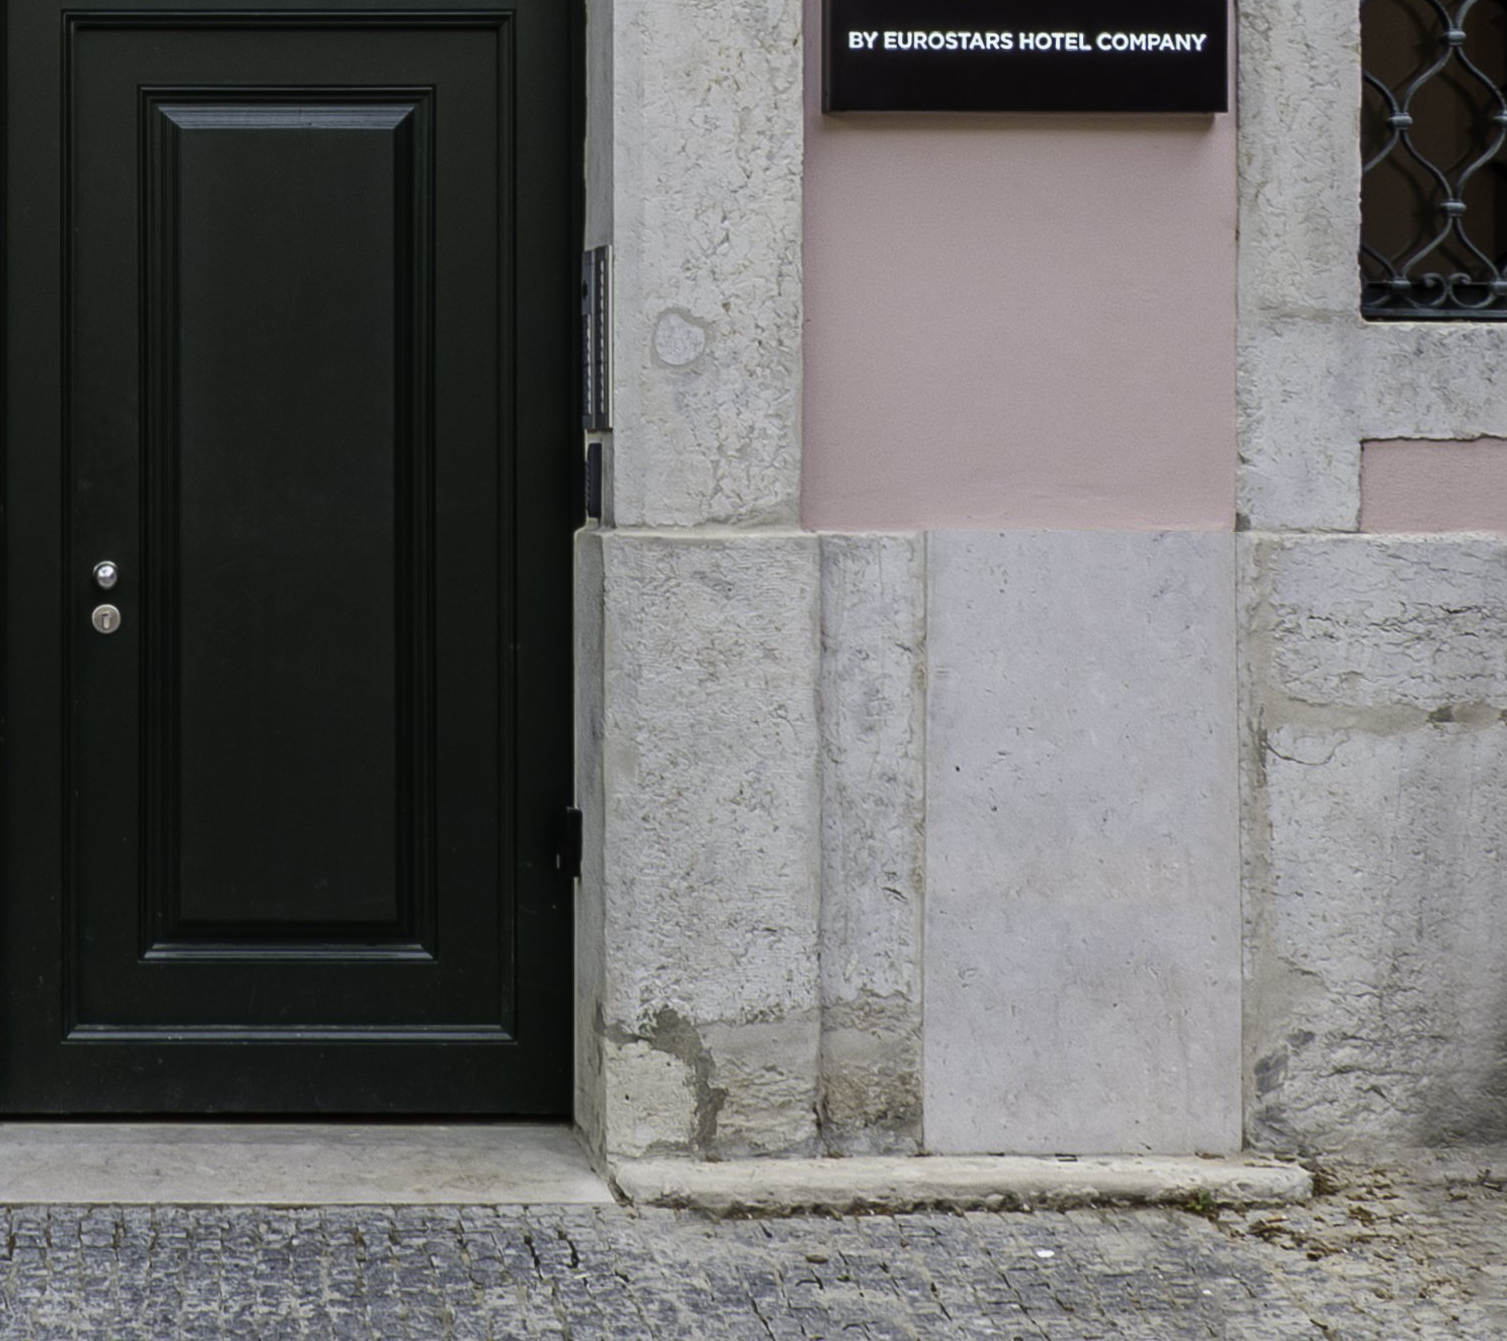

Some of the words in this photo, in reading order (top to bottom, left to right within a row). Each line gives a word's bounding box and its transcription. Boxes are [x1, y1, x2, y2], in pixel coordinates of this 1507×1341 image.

[848, 30, 879, 50] BY
[883, 30, 1014, 51] EUROSTARS
[1018, 31, 1093, 51] HOTEL
[1095, 31, 1208, 52] COMPANY
